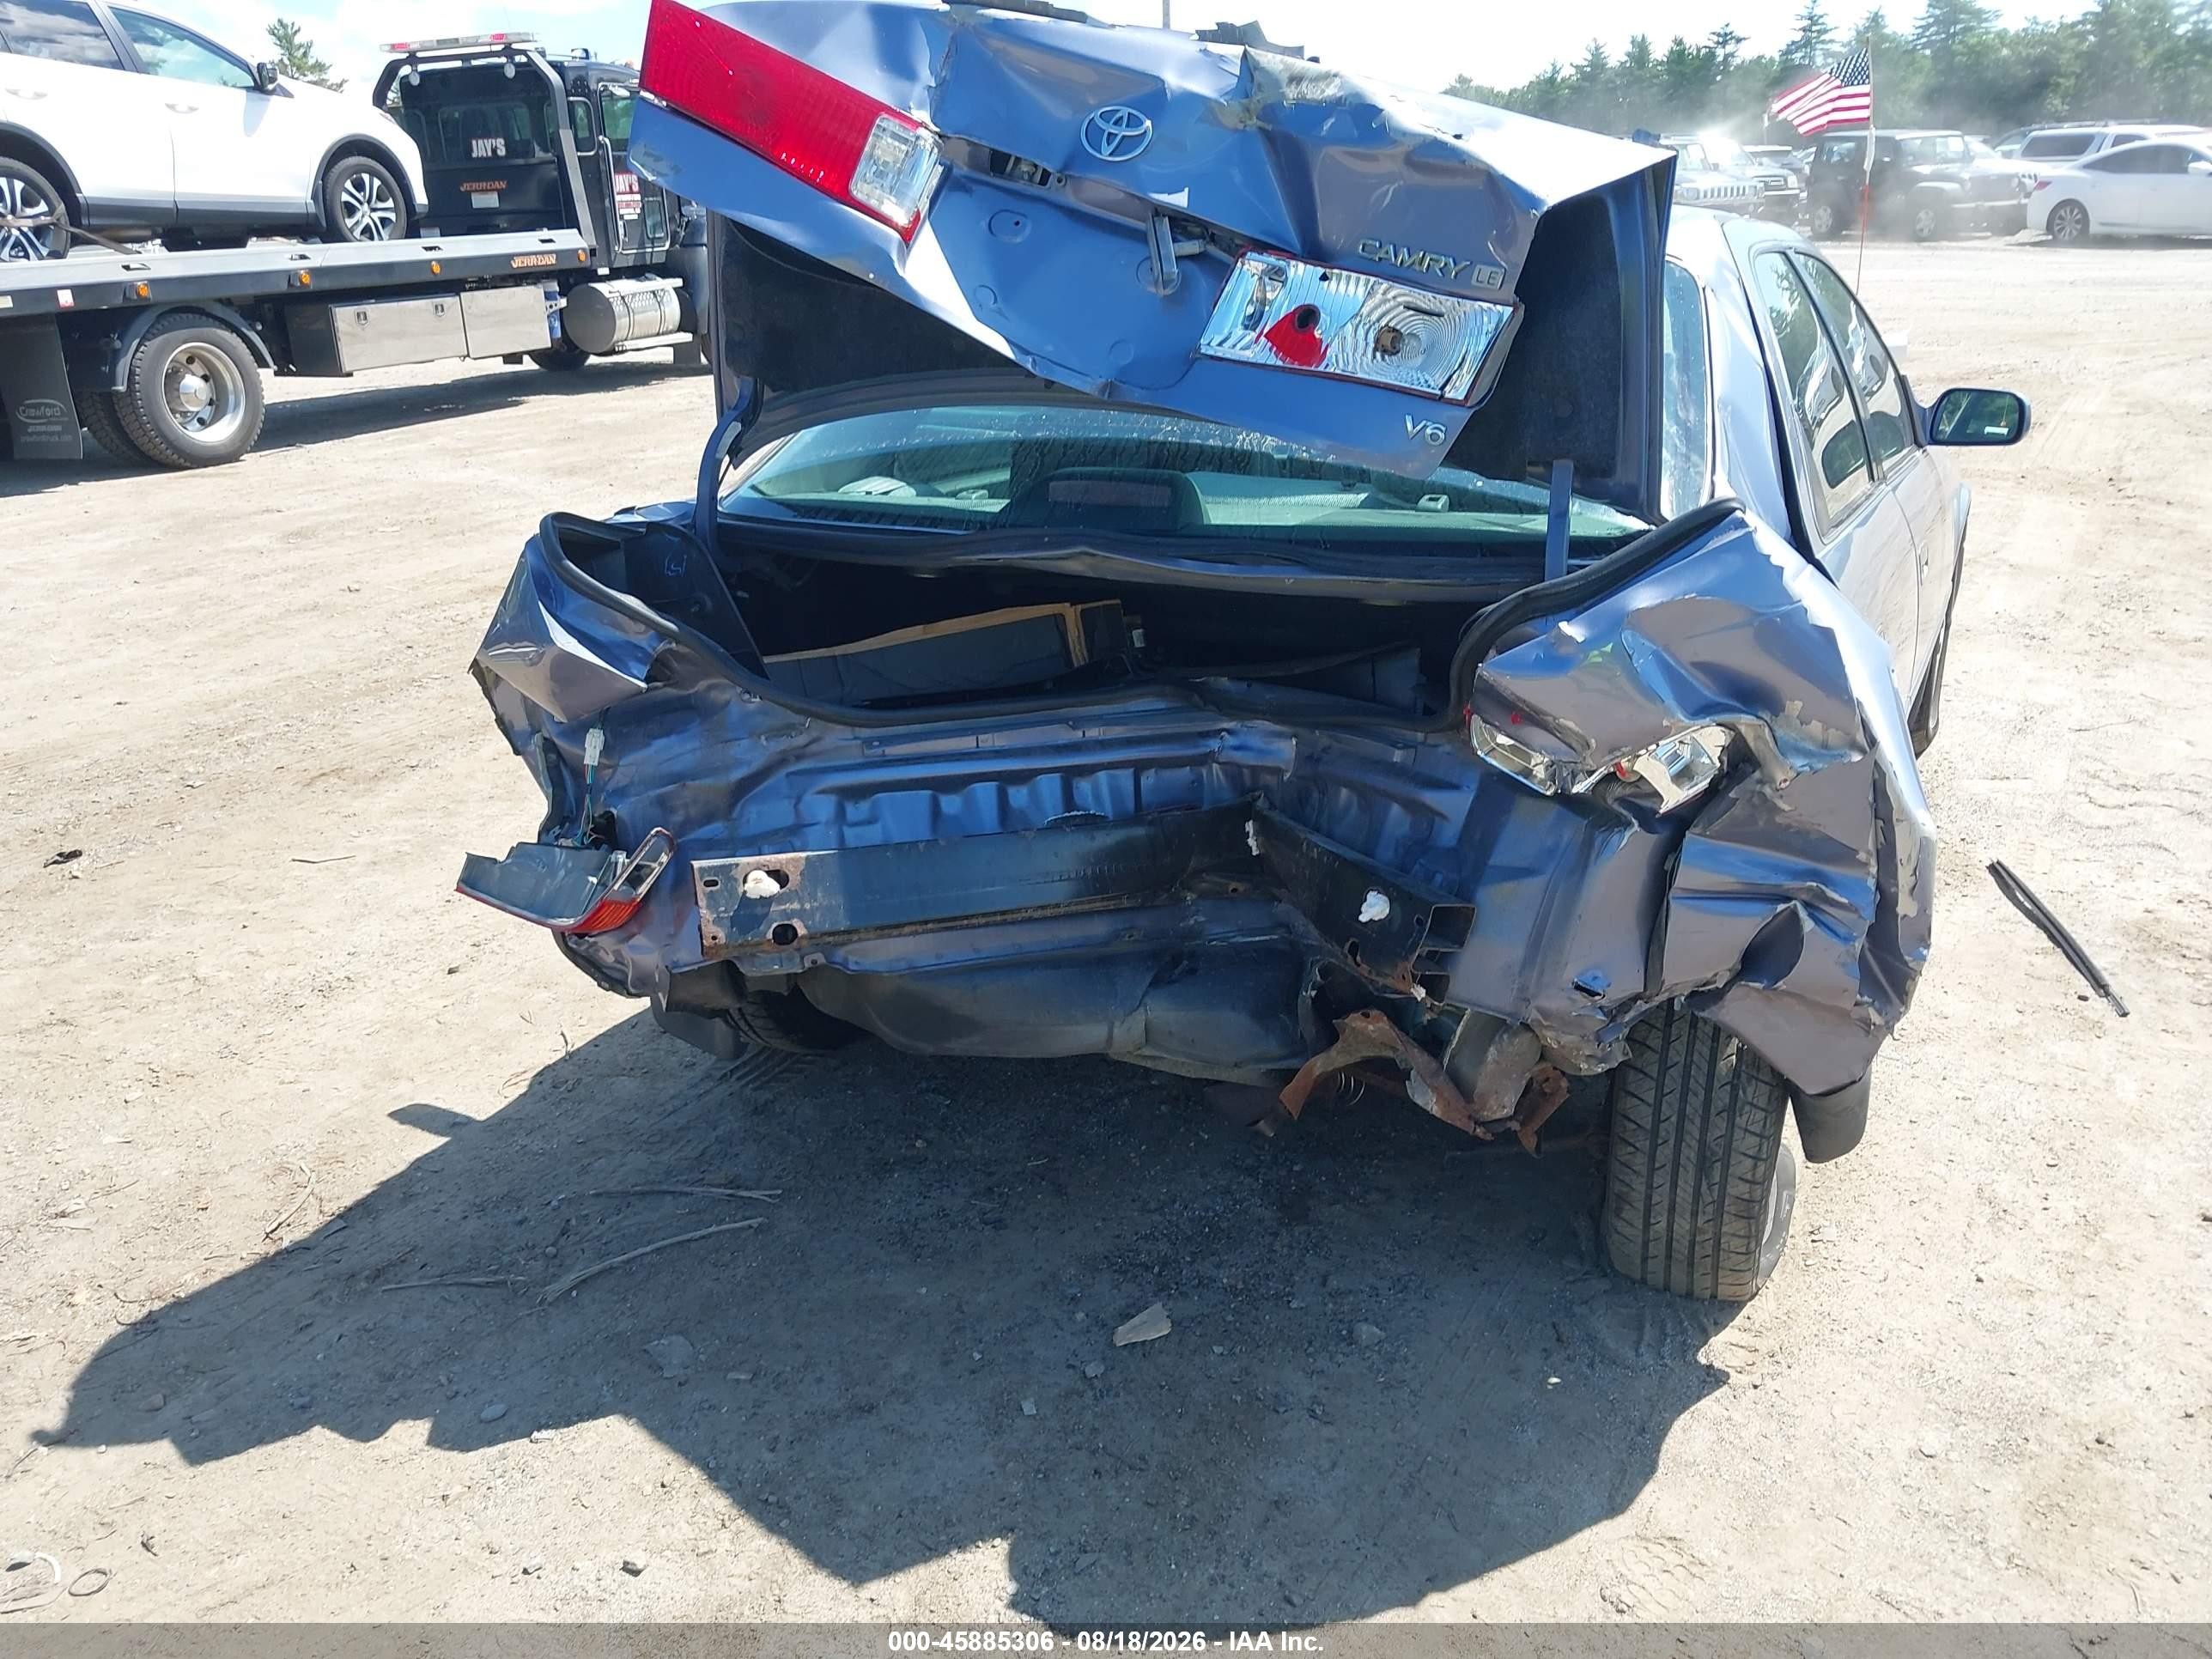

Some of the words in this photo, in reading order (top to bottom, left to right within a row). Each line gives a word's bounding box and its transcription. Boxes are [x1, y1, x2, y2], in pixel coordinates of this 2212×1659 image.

[471, 137, 506, 158] JAY'S
[1359, 238, 1473, 279] CAMRY
[1475, 270, 1498, 287] LE
[1405, 413, 1447, 446] V6
